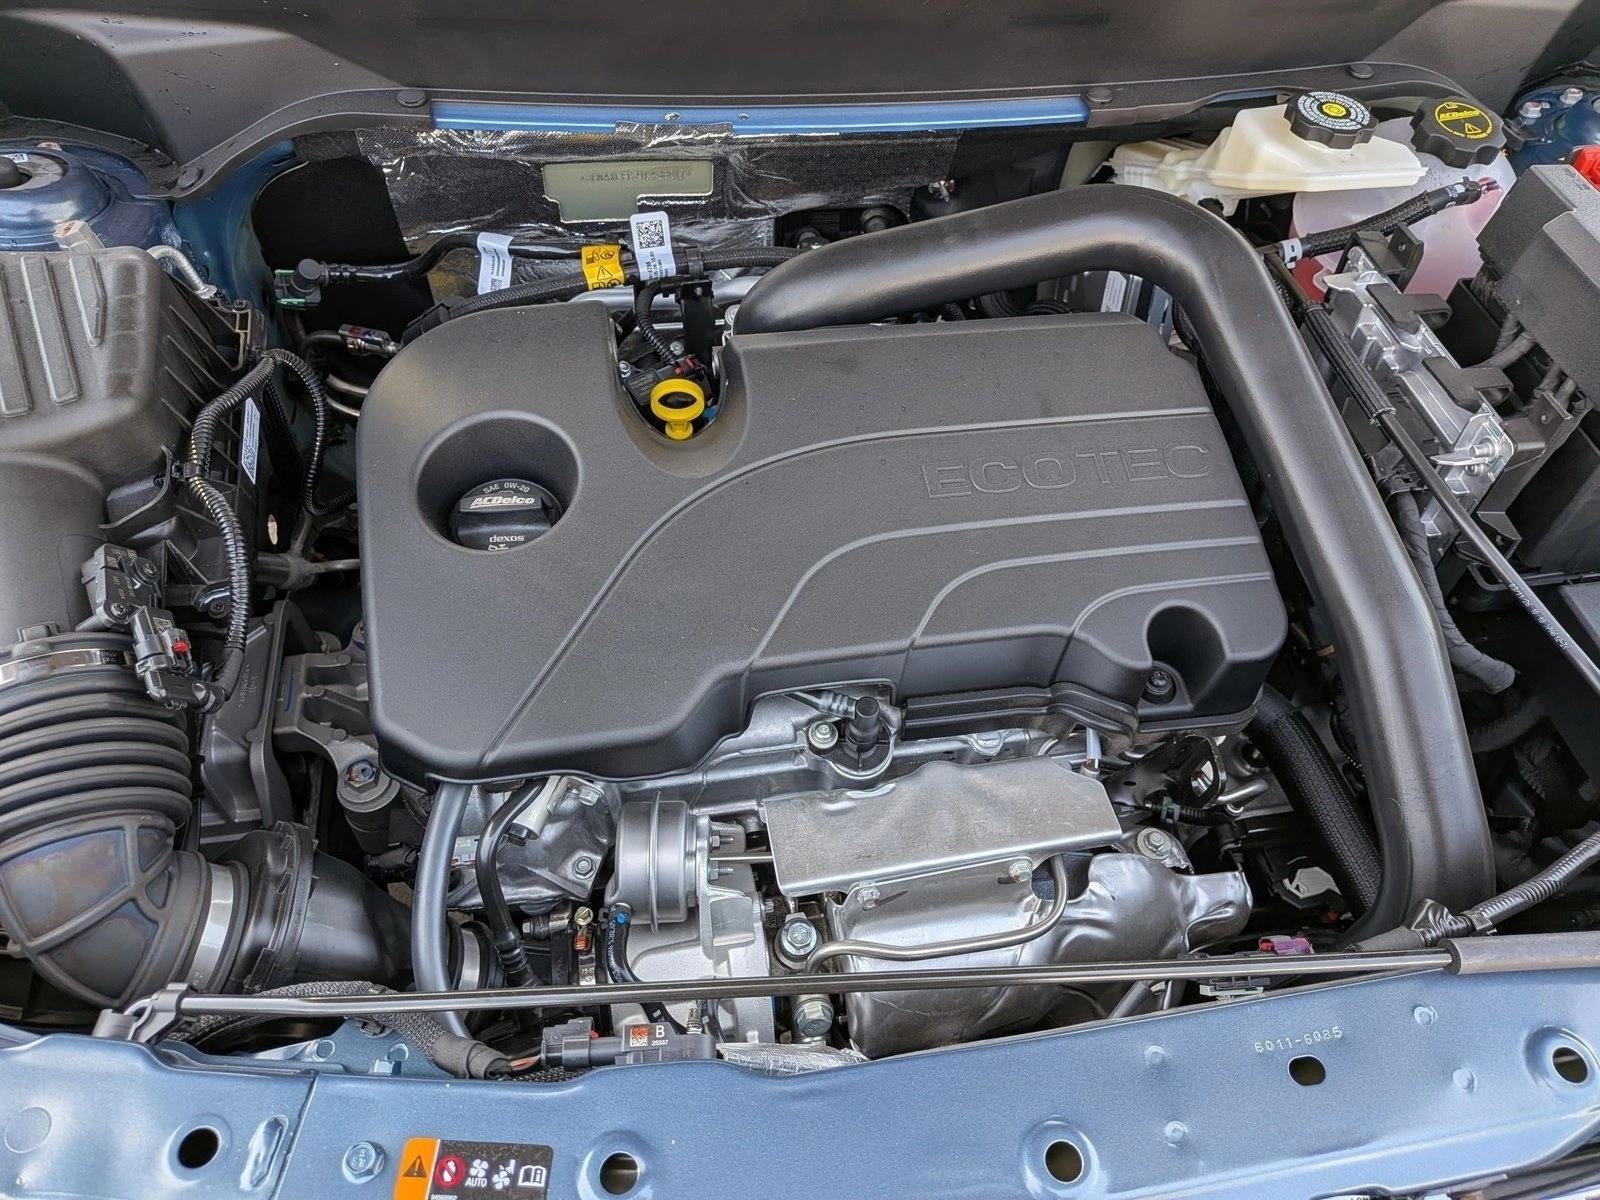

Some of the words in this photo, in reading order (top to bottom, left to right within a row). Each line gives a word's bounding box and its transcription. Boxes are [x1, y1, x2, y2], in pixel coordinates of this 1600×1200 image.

[1439, 109, 1481, 121] ACDelco
[921, 441, 1212, 499] ECOTEC
[483, 484, 500, 494] SAE
[503, 482, 531, 494] 0W-20
[469, 495, 536, 508] ACDelco
[489, 535, 526, 543] dexos
[655, 1025, 666, 1038] B
[465, 1177, 488, 1187] AUTO
